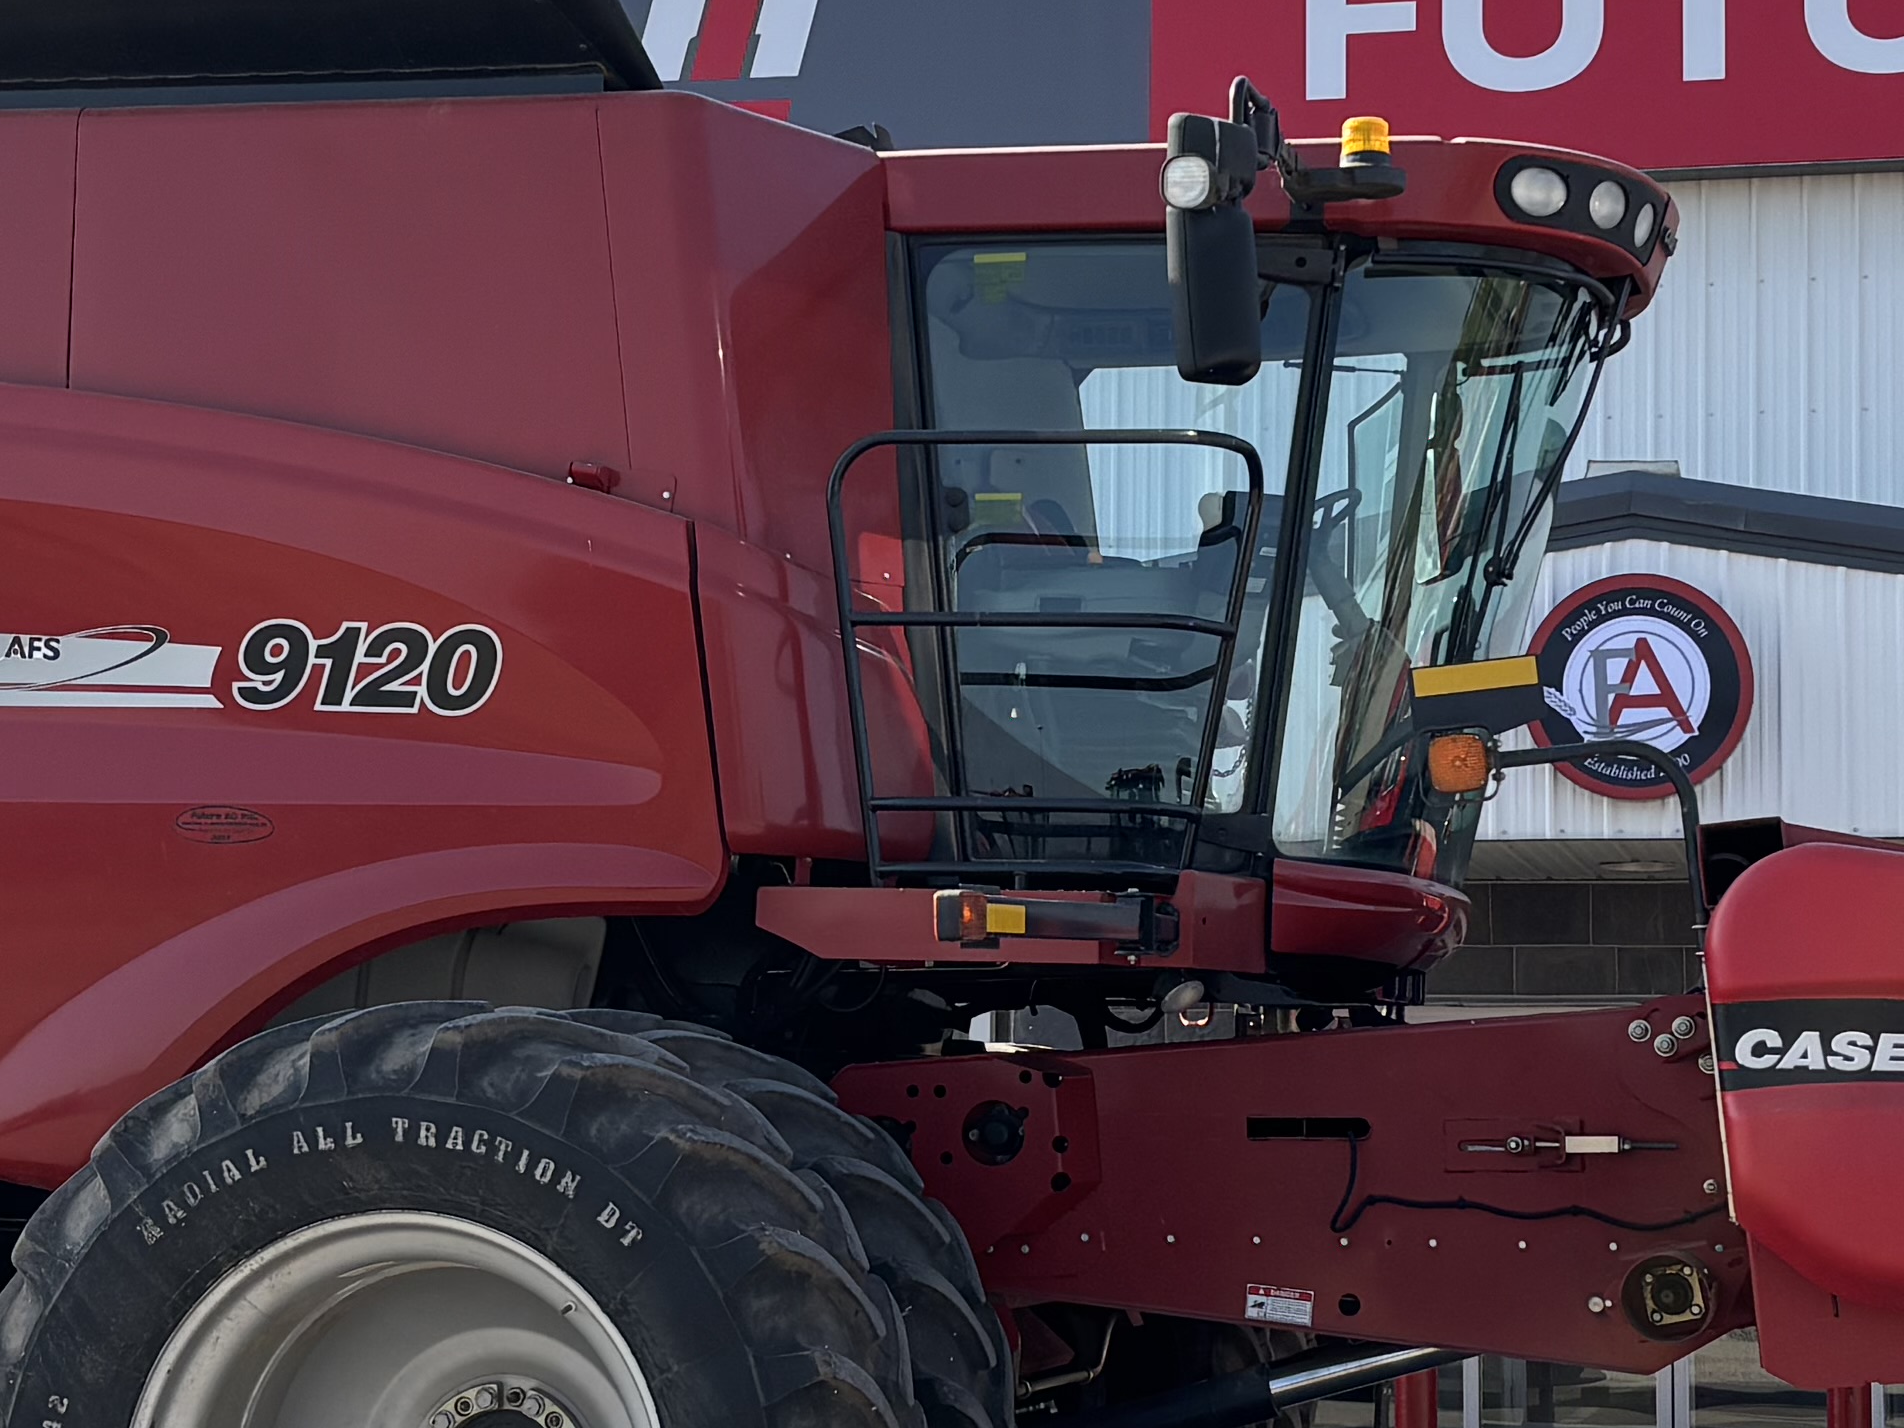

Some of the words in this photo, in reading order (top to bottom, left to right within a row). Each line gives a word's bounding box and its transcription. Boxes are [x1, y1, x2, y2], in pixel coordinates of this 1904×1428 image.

[4, 635, 61, 661] AFS
[1561, 608, 1598, 641] People
[1597, 600, 1622, 615] You
[1625, 595, 1652, 609] Can
[1654, 598, 1692, 623] Count
[1690, 618, 1709, 638] On
[231, 618, 503, 717] 9120
[135, 1147, 268, 1246] RADIAL
[292, 1121, 364, 1155] ALL
[391, 1117, 582, 1199] TRACTION
[596, 1201, 643, 1248] DT
